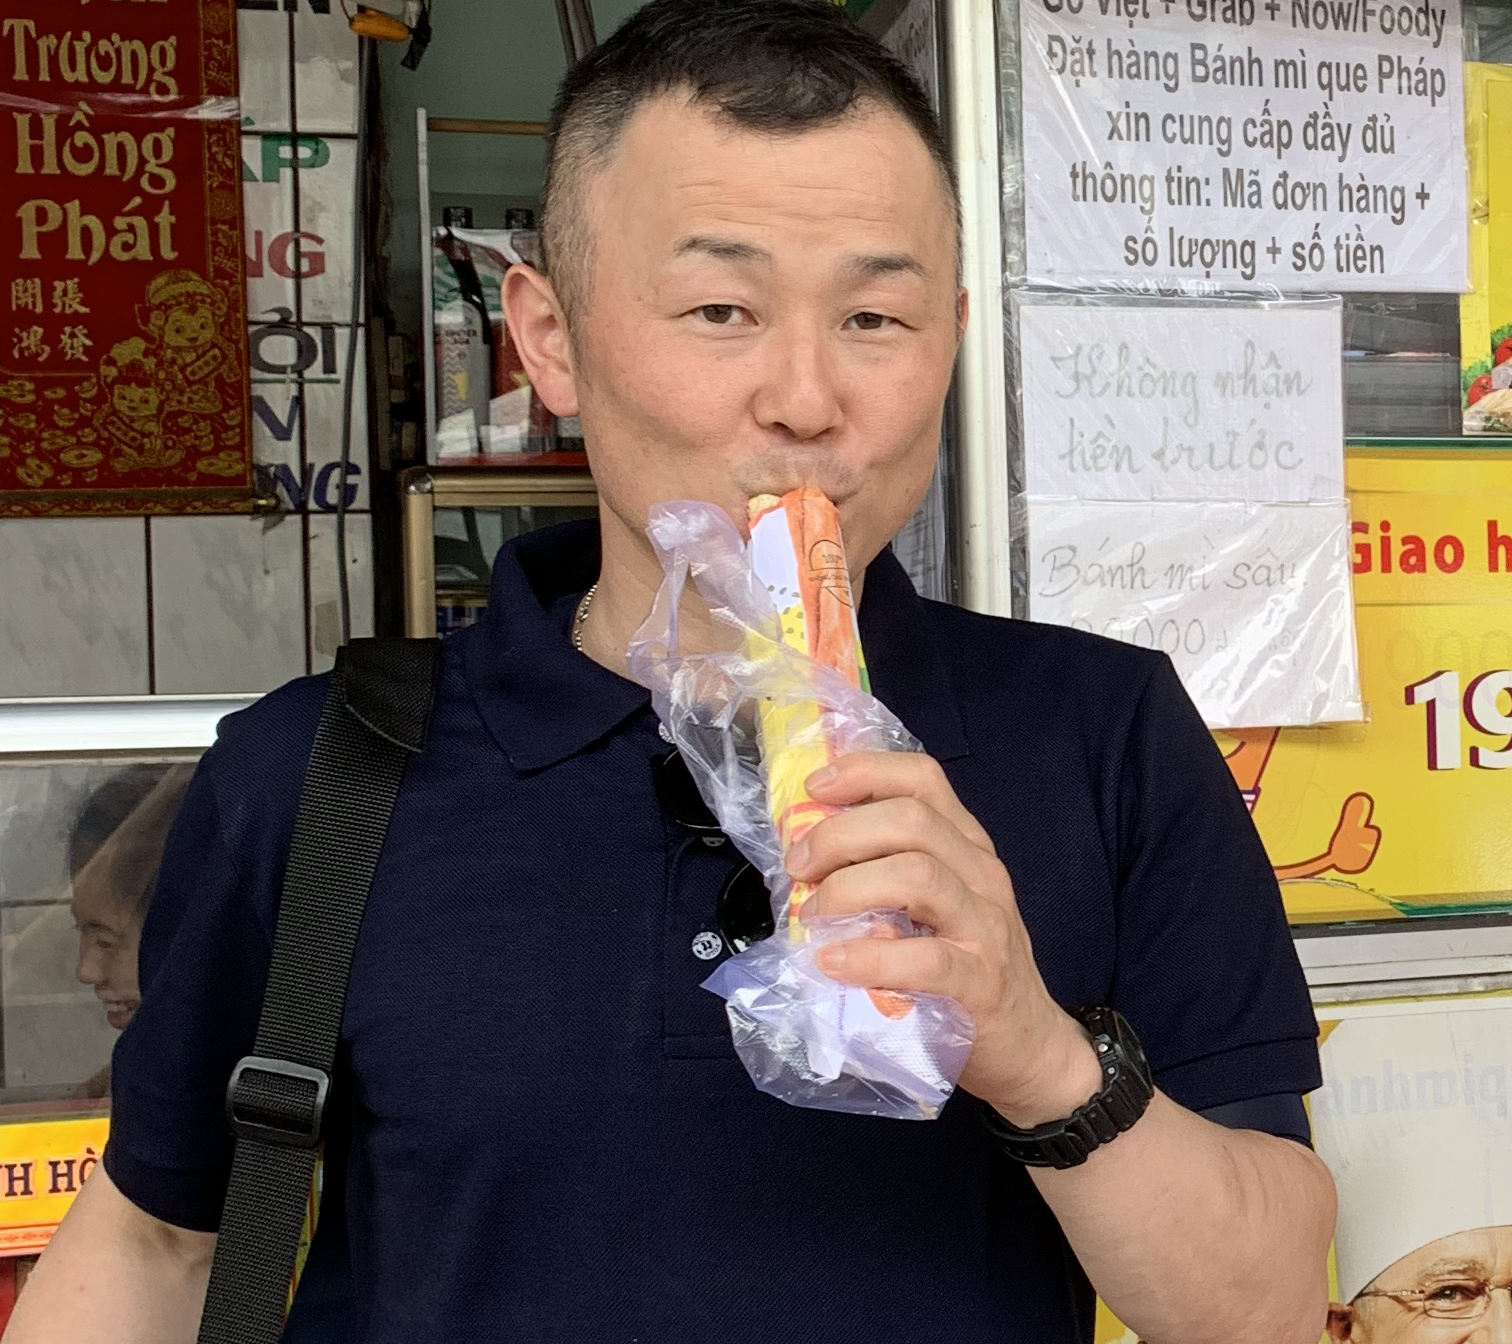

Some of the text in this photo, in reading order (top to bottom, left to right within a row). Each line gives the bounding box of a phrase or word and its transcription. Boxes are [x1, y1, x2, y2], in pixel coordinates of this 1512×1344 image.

[3, 19, 177, 102] Trương
[1046, 34, 1447, 107] Đặt hàng Bánh mì que Pháp
[1107, 99, 1396, 163] xin cung cấp đầy đủ
[1070, 162, 1431, 225] thông tin: Mã đơn hàng +
[16, 198, 179, 266] Phát
[1123, 216, 1385, 281] số lượng + số tiền
[1039, 535, 1216, 597] Bánh mì
[1351, 519, 1465, 574] Giao
